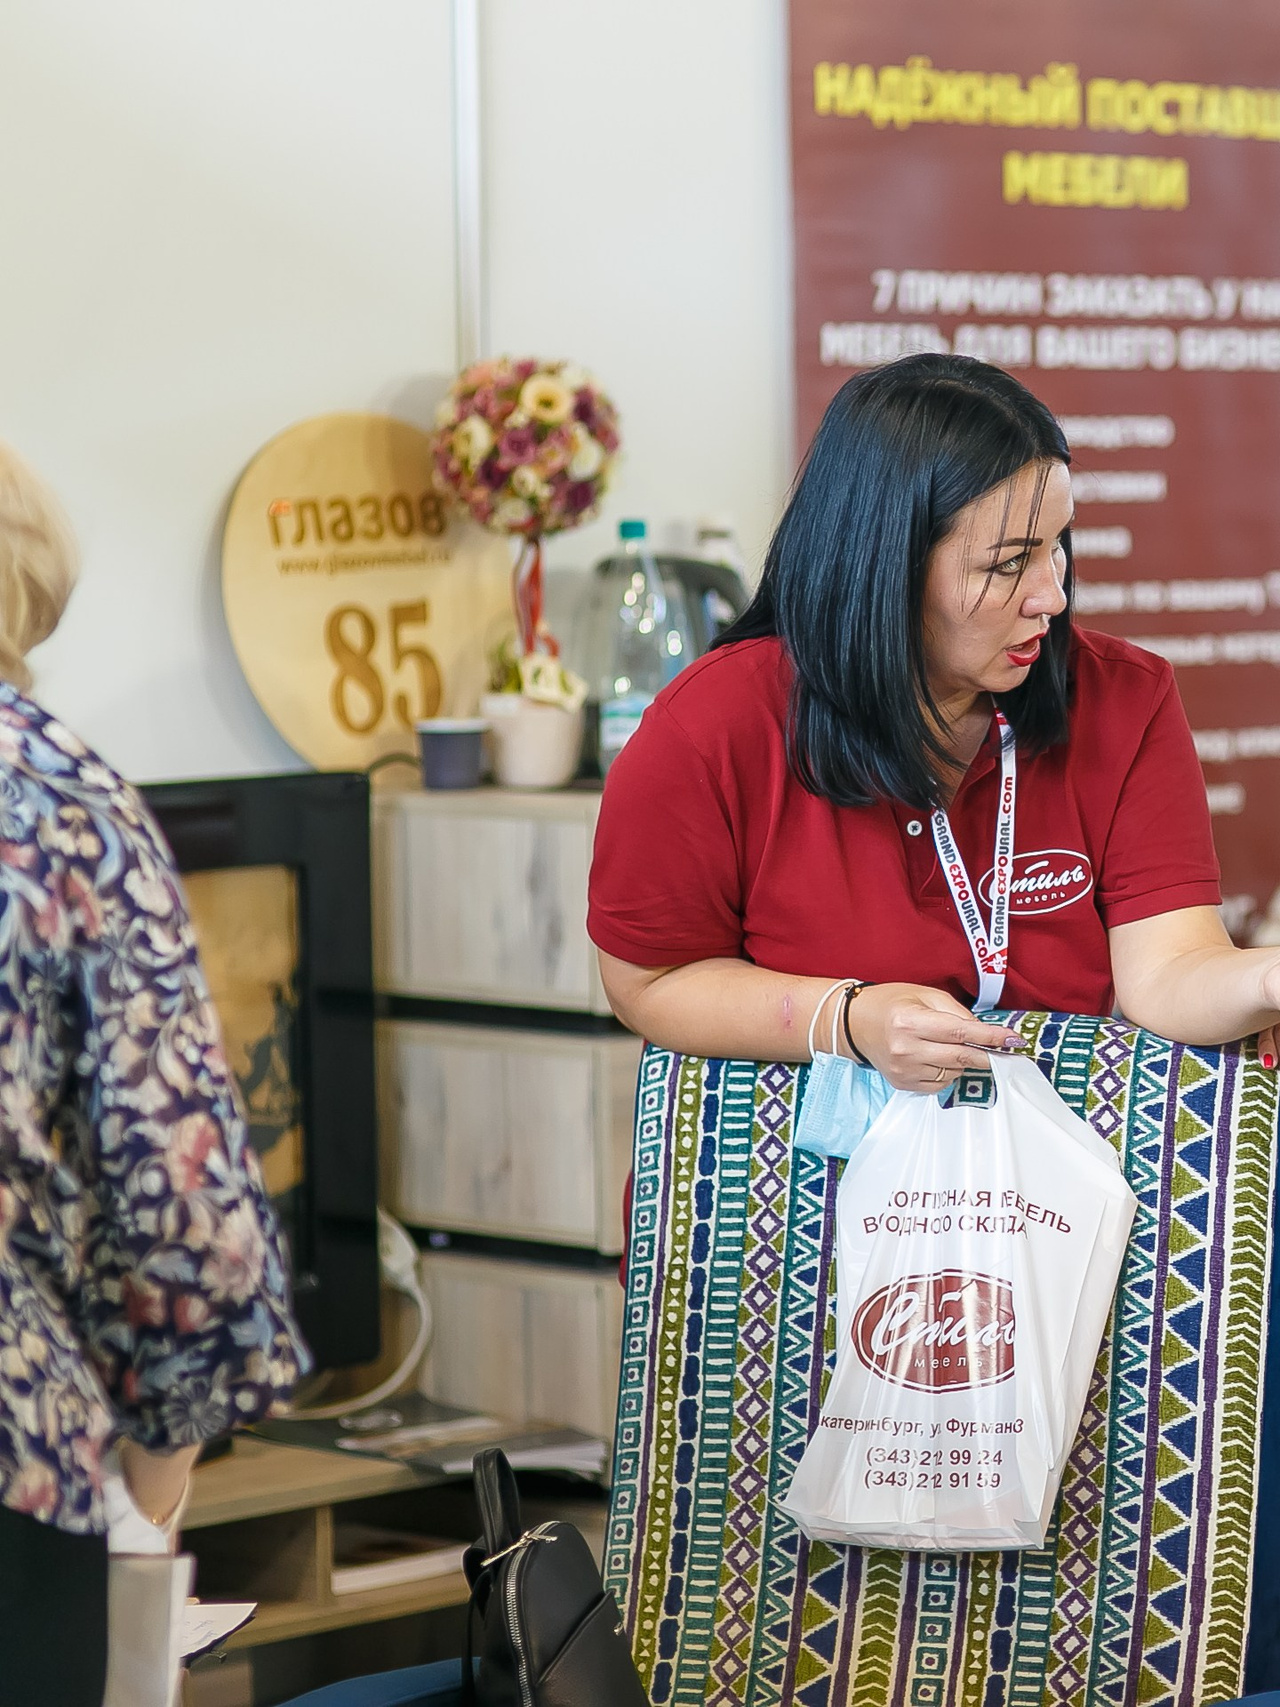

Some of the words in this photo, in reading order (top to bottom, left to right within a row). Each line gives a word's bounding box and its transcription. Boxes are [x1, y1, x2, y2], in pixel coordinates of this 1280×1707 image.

[813, 55, 1080, 131] НАДЁЖНЫЙ
[1003, 150, 1188, 209] МЕБЕЛИ
[871, 269, 896, 313] 7
[897, 270, 1042, 315] ПРИЧИН
[1045, 272, 1213, 320] ЗАКАЗАТЬ
[1212, 277, 1239, 321] У
[1034, 324, 1175, 370] ВАШЕГО
[327, 599, 442, 734] 85
[888, 1189, 992, 1209] ОРПСНАЯ
[820, 1415, 925, 1438] катеринбург,
[949, 1449, 972, 1465] 99
[949, 1472, 970, 1488] 91
[976, 1472, 1001, 1488] 59
